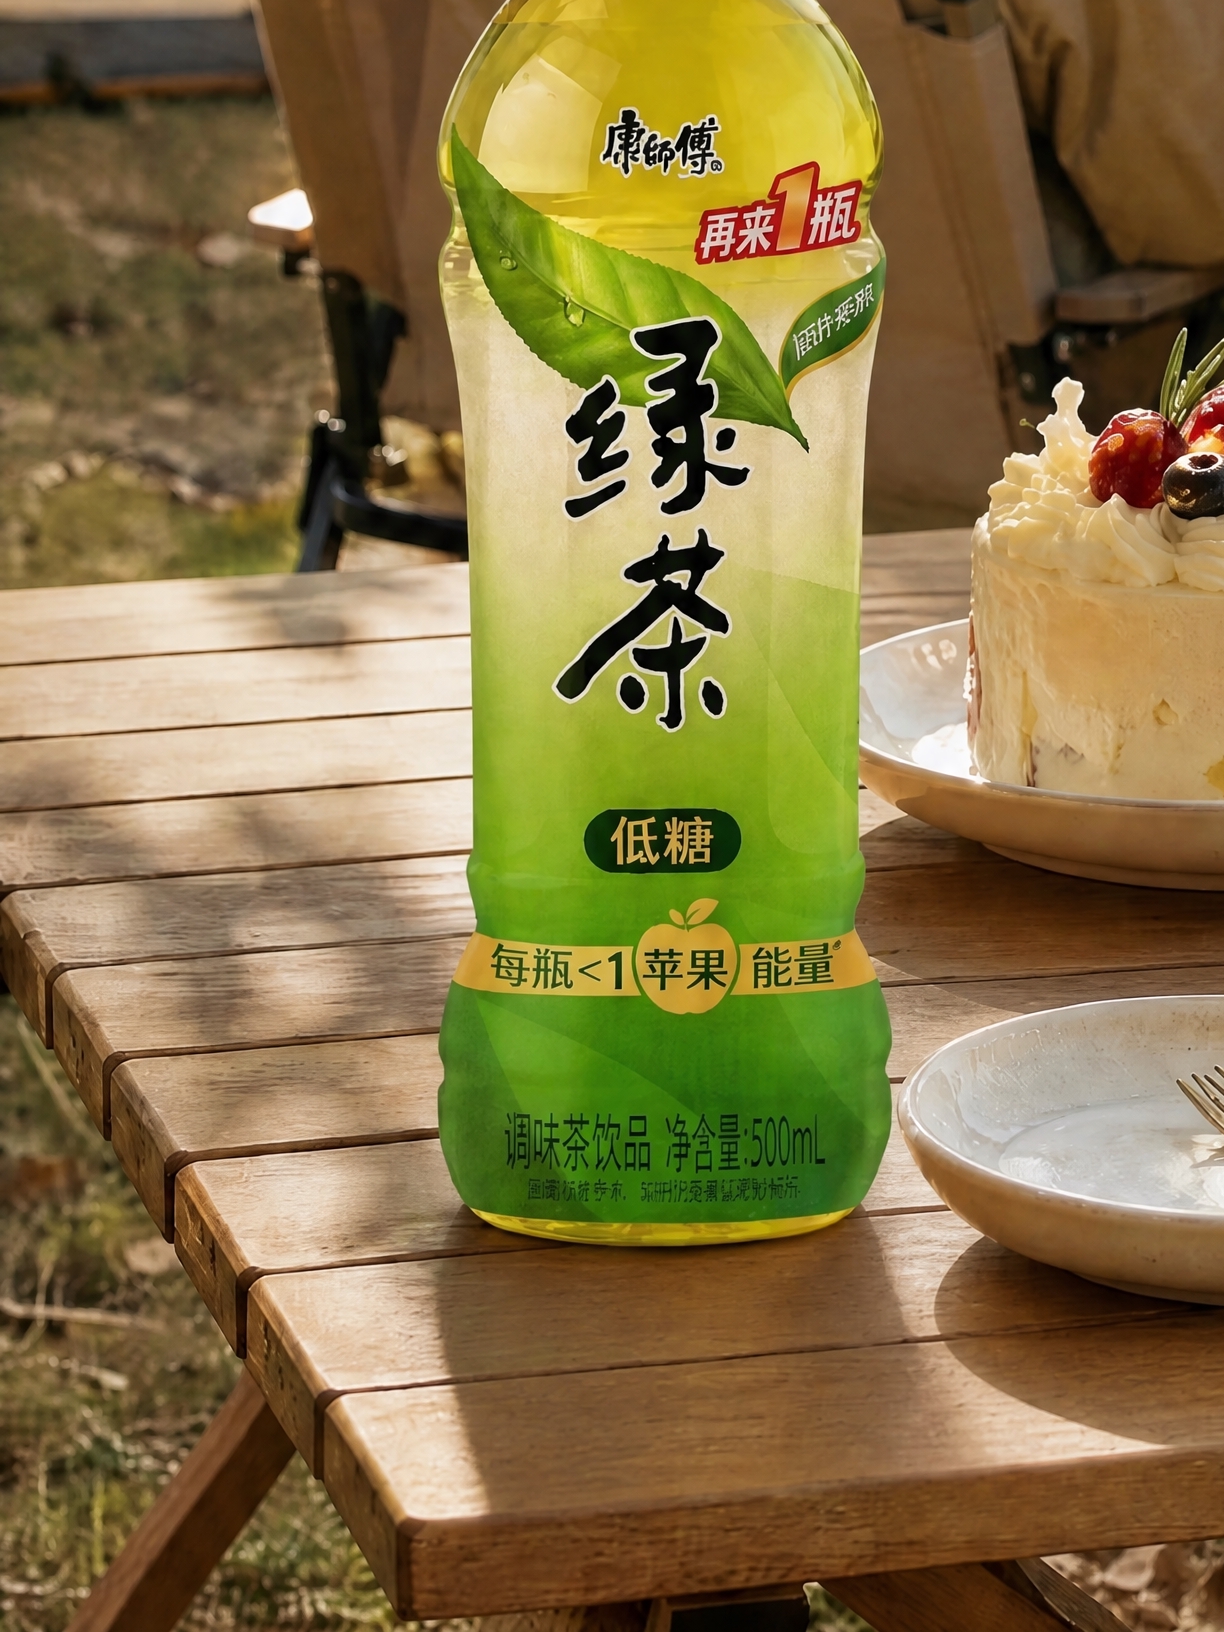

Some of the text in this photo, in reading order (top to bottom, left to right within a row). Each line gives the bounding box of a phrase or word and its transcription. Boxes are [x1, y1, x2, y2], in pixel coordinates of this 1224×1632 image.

[699, 166, 858, 260] 再来1瓶
[555, 316, 749, 730] 绿茶
[610, 816, 715, 866] 低糖
[504, 1111, 651, 1172] 调味茶饮品
